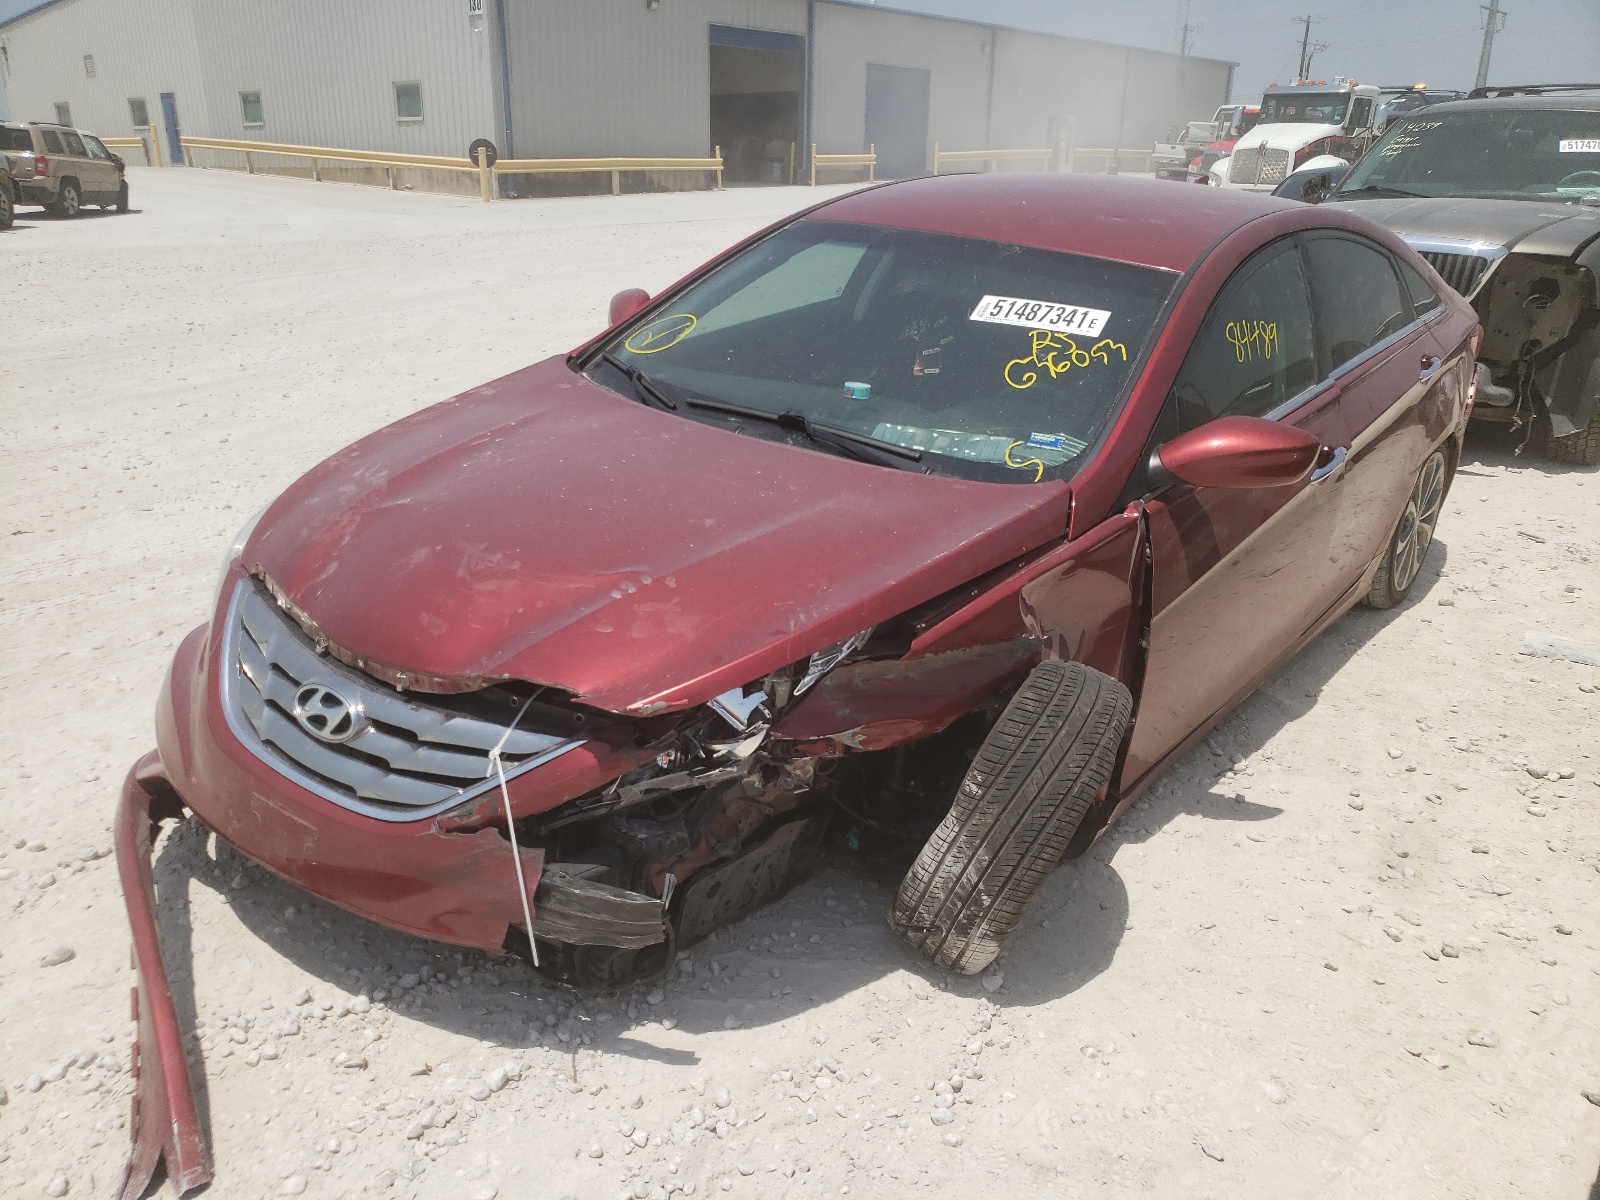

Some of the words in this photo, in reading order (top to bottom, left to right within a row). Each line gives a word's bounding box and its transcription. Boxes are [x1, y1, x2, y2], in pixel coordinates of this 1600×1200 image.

[989, 299, 1090, 329] 51487341
[1088, 318, 1098, 329] E
[1225, 319, 1279, 363] 84489
